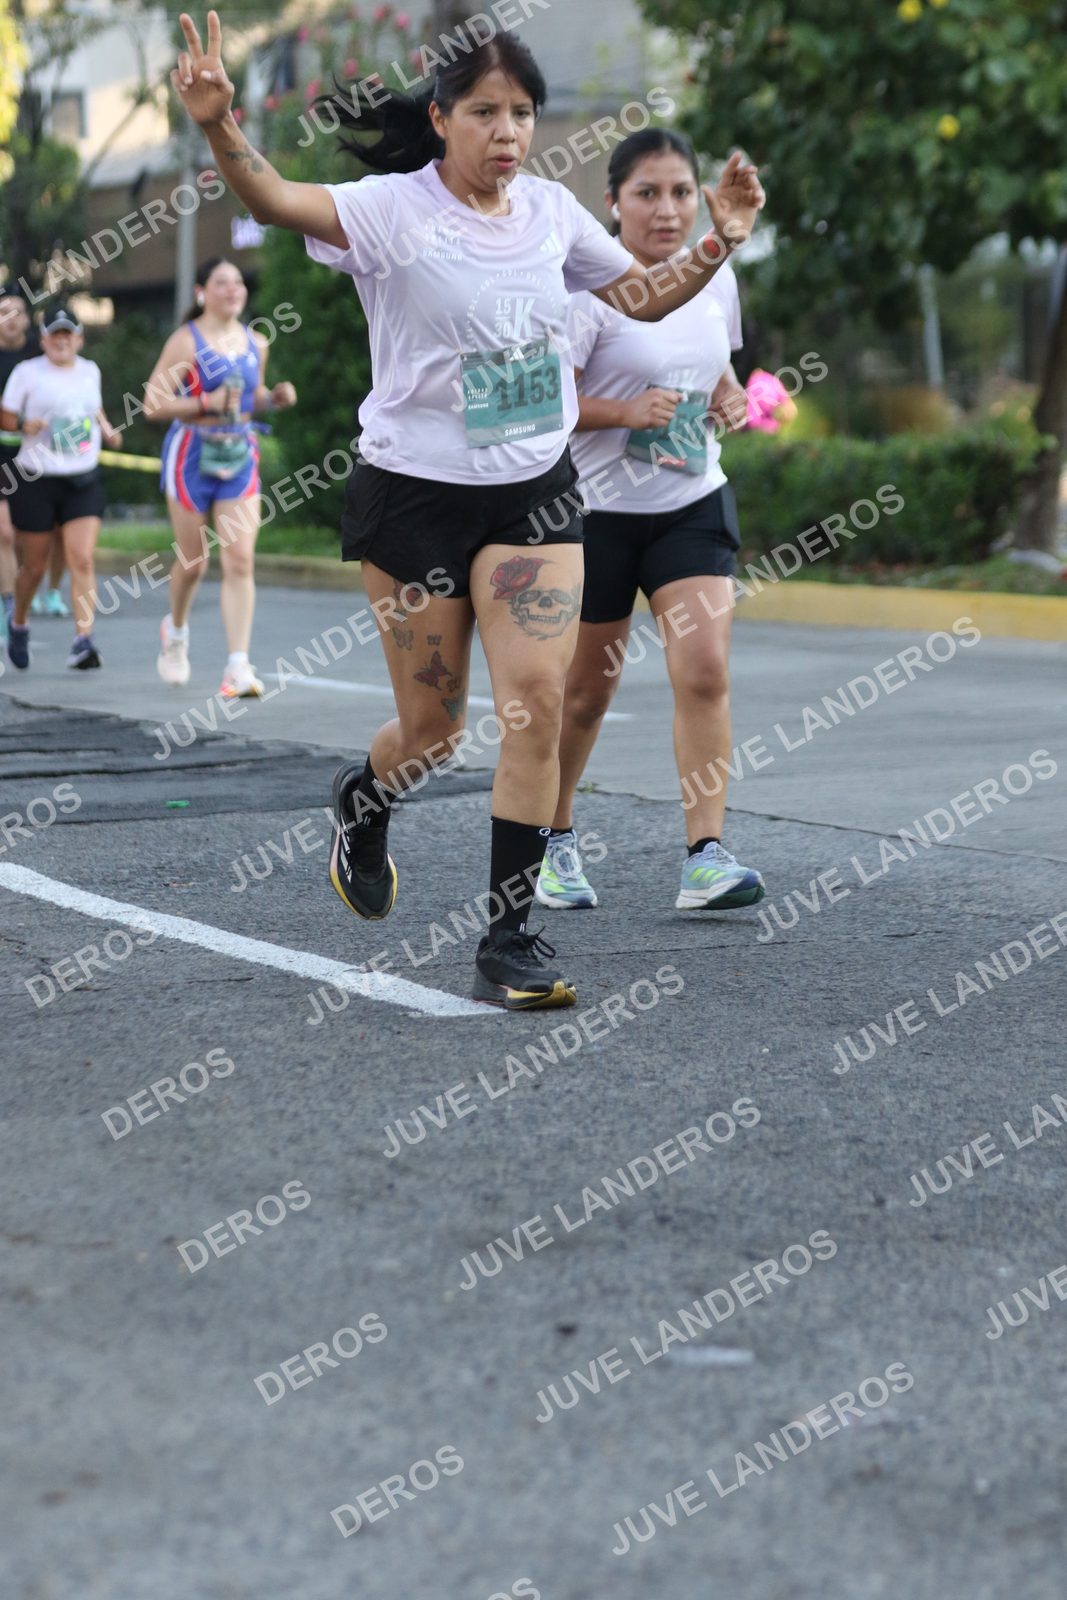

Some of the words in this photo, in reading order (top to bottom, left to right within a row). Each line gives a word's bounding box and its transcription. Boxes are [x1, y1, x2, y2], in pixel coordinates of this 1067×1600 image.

[495, 296, 512, 315] 15
[513, 297, 537, 337] K
[494, 320, 512, 338] 30
[496, 366, 560, 412] 1153
[504, 424, 536, 437] SAMSUNG
